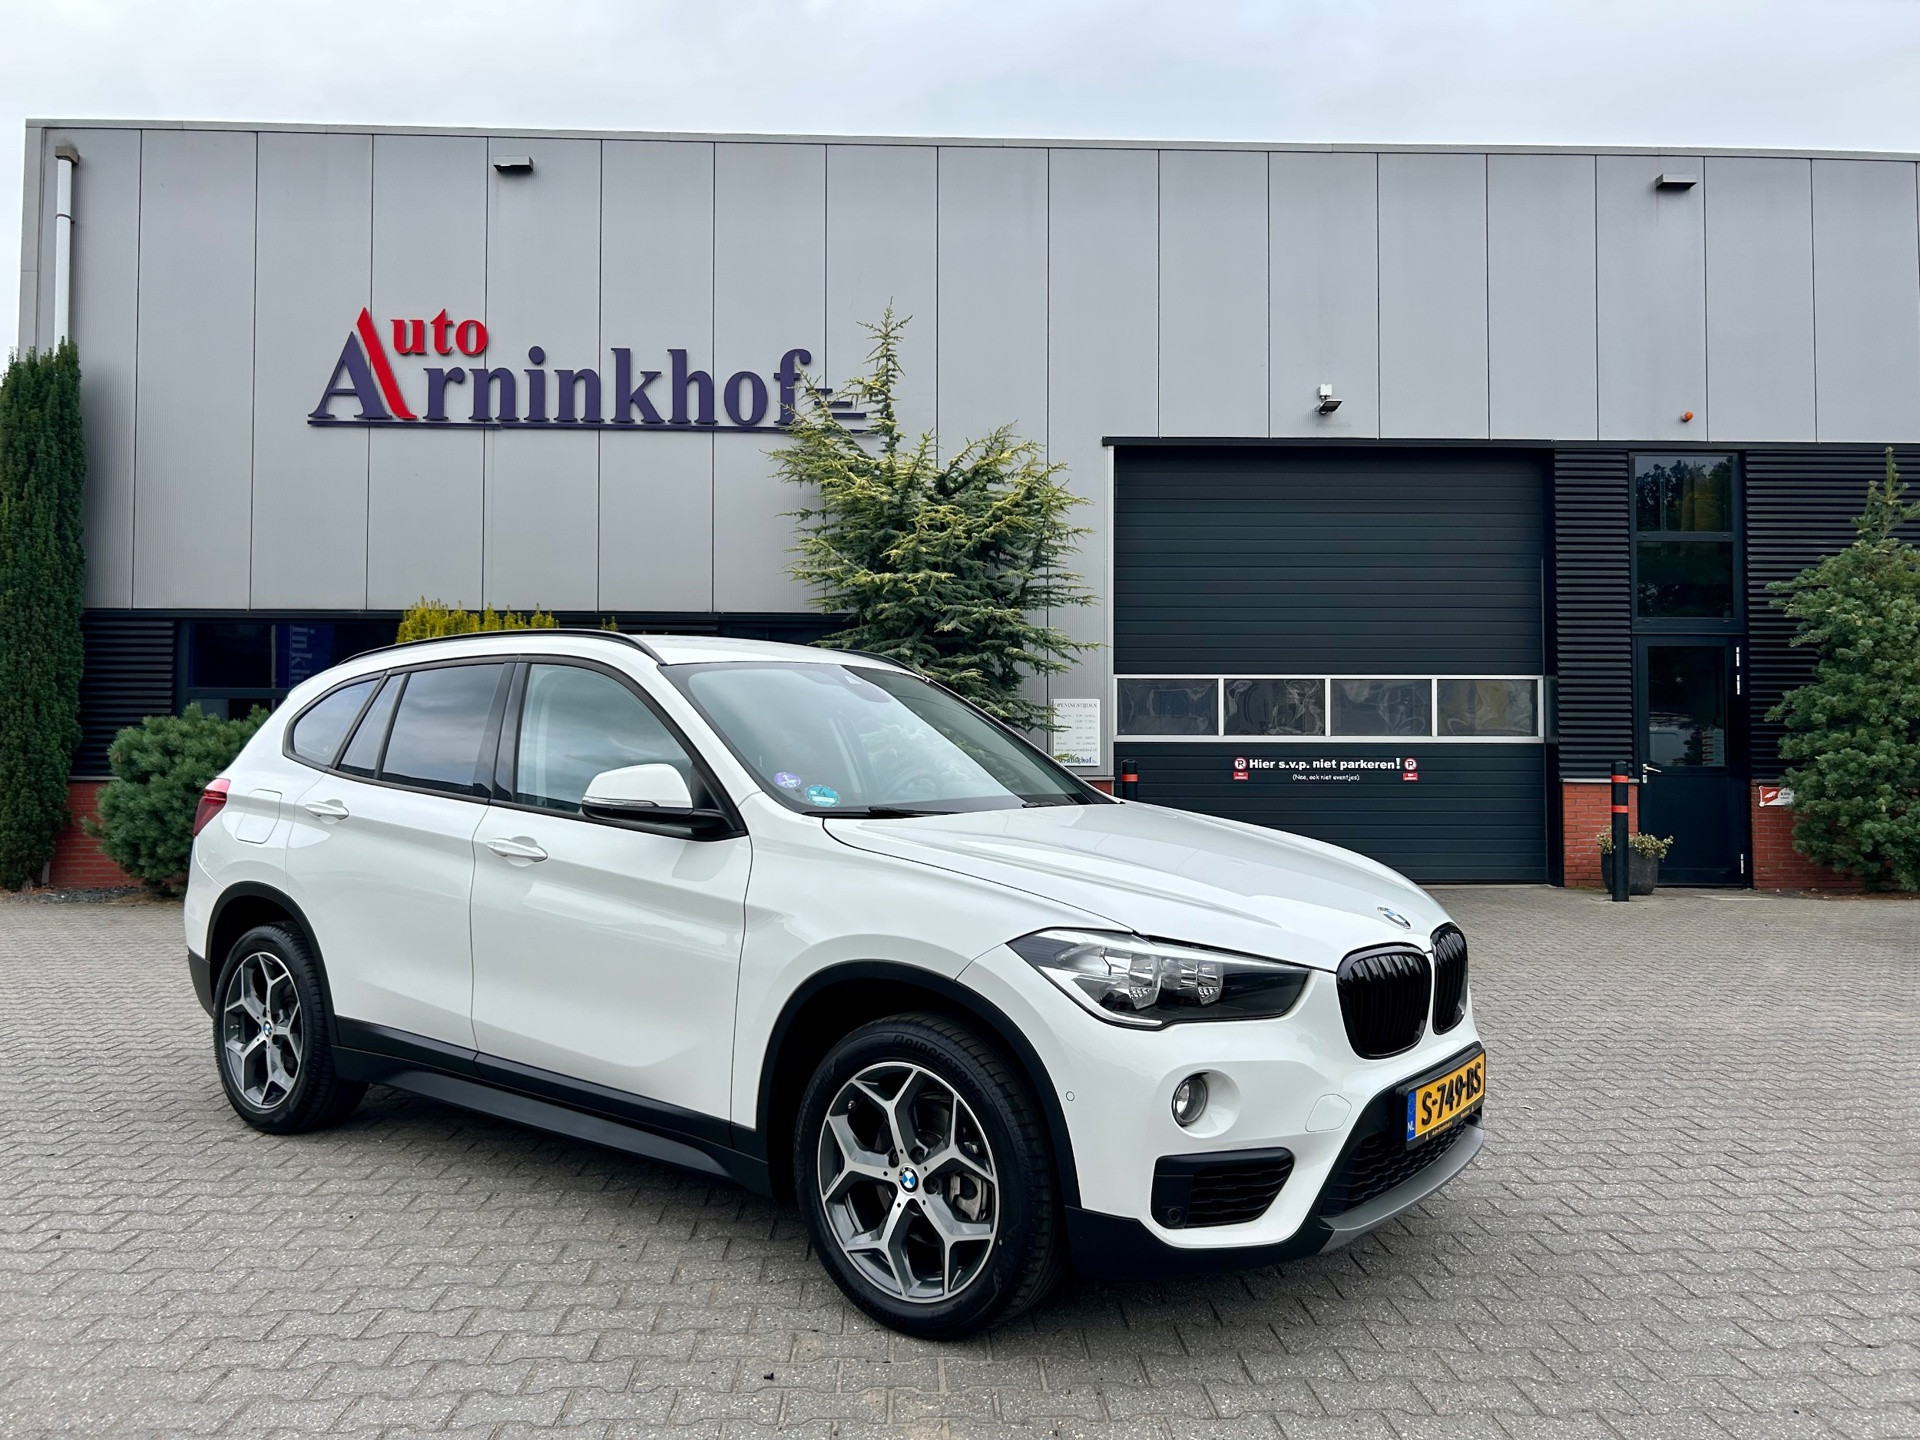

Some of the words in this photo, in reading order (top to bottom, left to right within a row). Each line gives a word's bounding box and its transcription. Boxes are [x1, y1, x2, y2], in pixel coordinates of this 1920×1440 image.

[308, 330, 812, 426] Arninkhof
[1249, 758, 1276, 769] Hier
[1278, 760, 1310, 771] s.v.p.
[1312, 758, 1337, 769] niet
[1339, 757, 1401, 771] parkeren!
[1320, 773, 1332, 781] niet
[1407, 1120, 1415, 1132] NL
